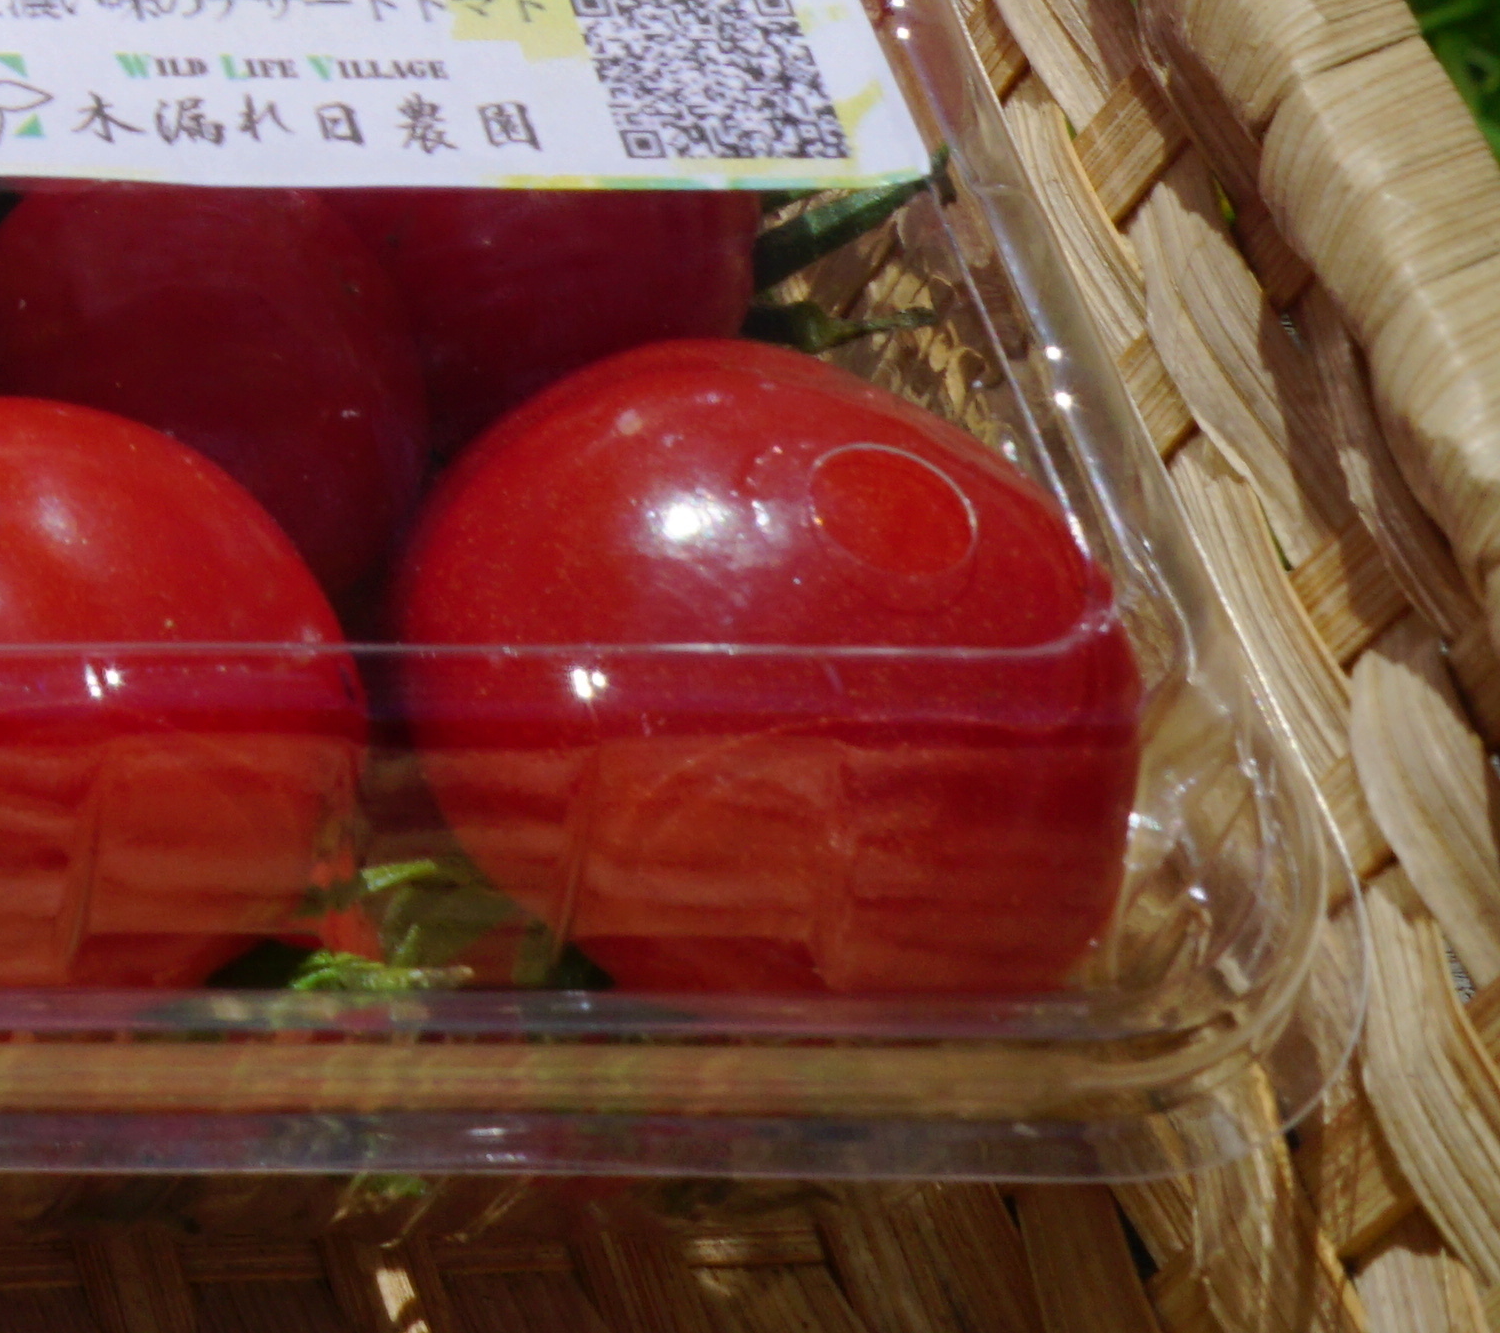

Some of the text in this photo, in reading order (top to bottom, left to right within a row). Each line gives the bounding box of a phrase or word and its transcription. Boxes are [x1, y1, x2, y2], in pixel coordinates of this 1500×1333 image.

[75, 91, 542, 155] 木漏れ日農園
